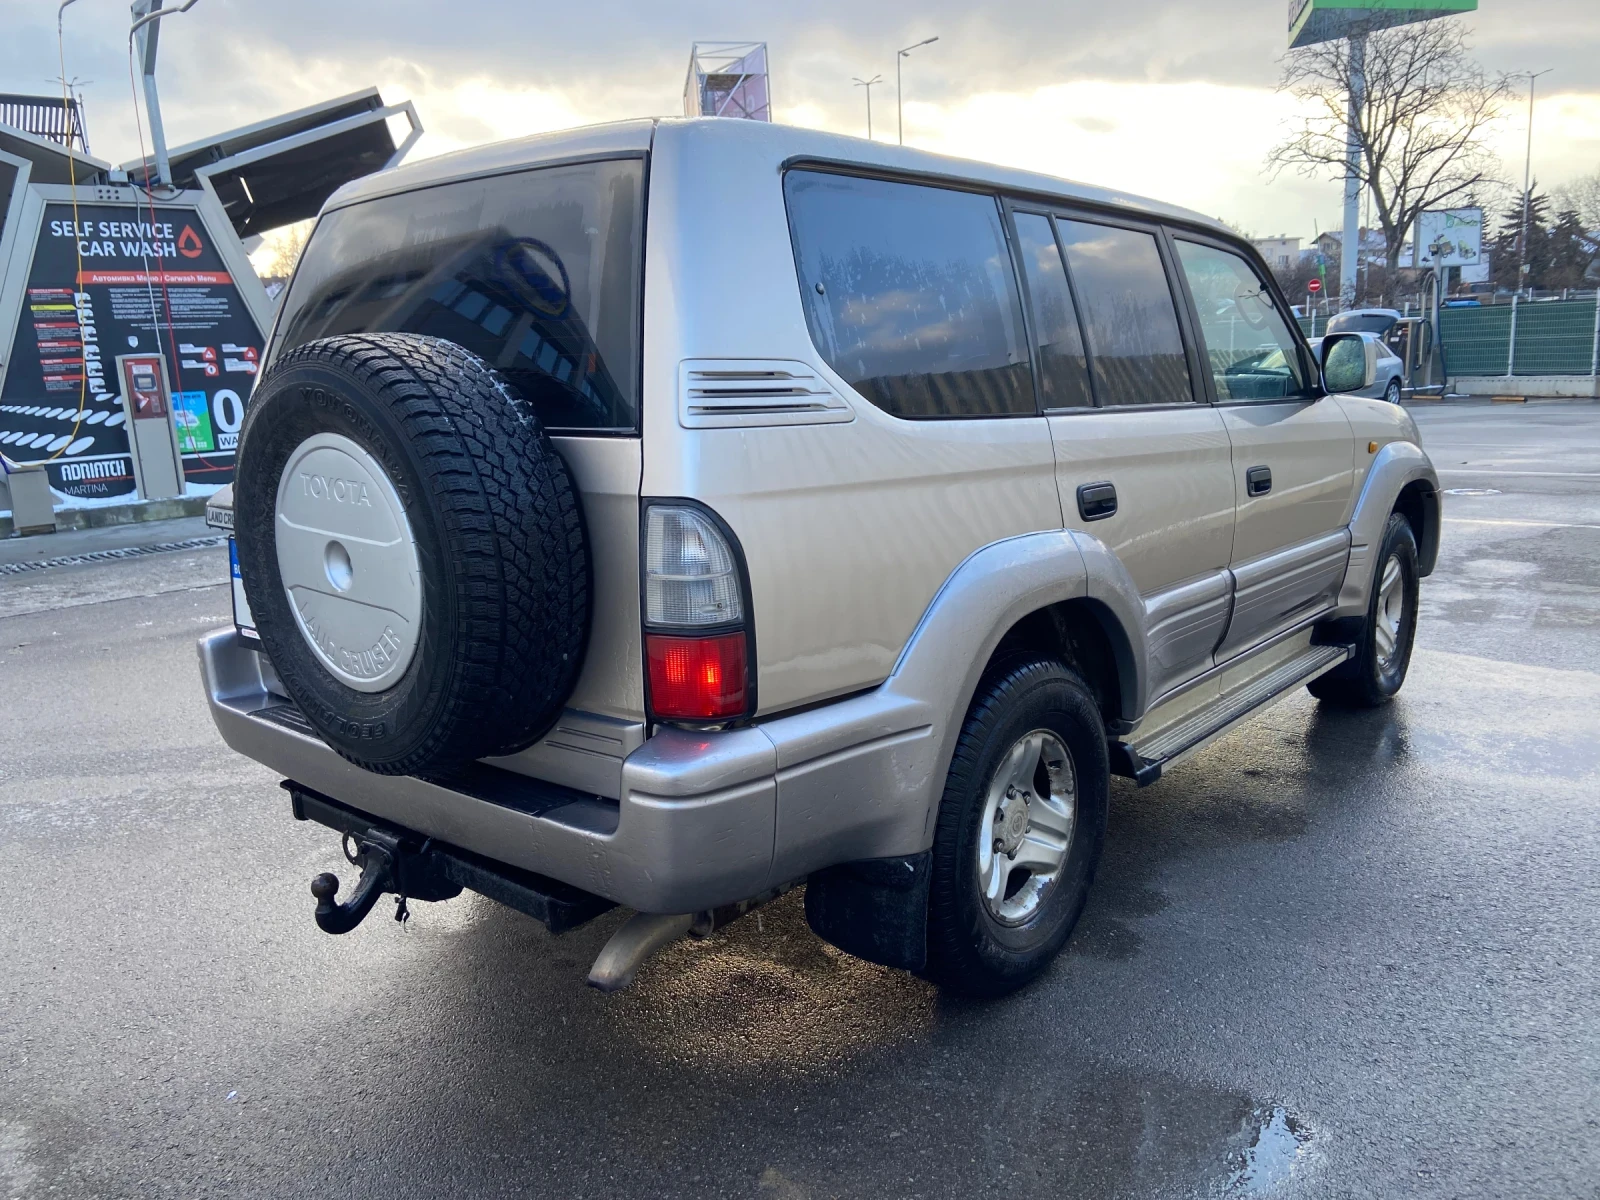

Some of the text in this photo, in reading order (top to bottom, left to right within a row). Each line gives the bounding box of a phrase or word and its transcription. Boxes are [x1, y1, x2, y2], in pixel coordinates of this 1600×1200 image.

[51, 220, 174, 239] SELF SERVICE
[77, 241, 177, 257] CAR WASH
[92, 274, 135, 282] Автомивка
[164, 274, 198, 282] Carwash
[64, 483, 108, 496] MARTINA
[300, 472, 372, 507] TOYOTA
[208, 510, 223, 523] LAND
[340, 624, 402, 675] CRUISER
